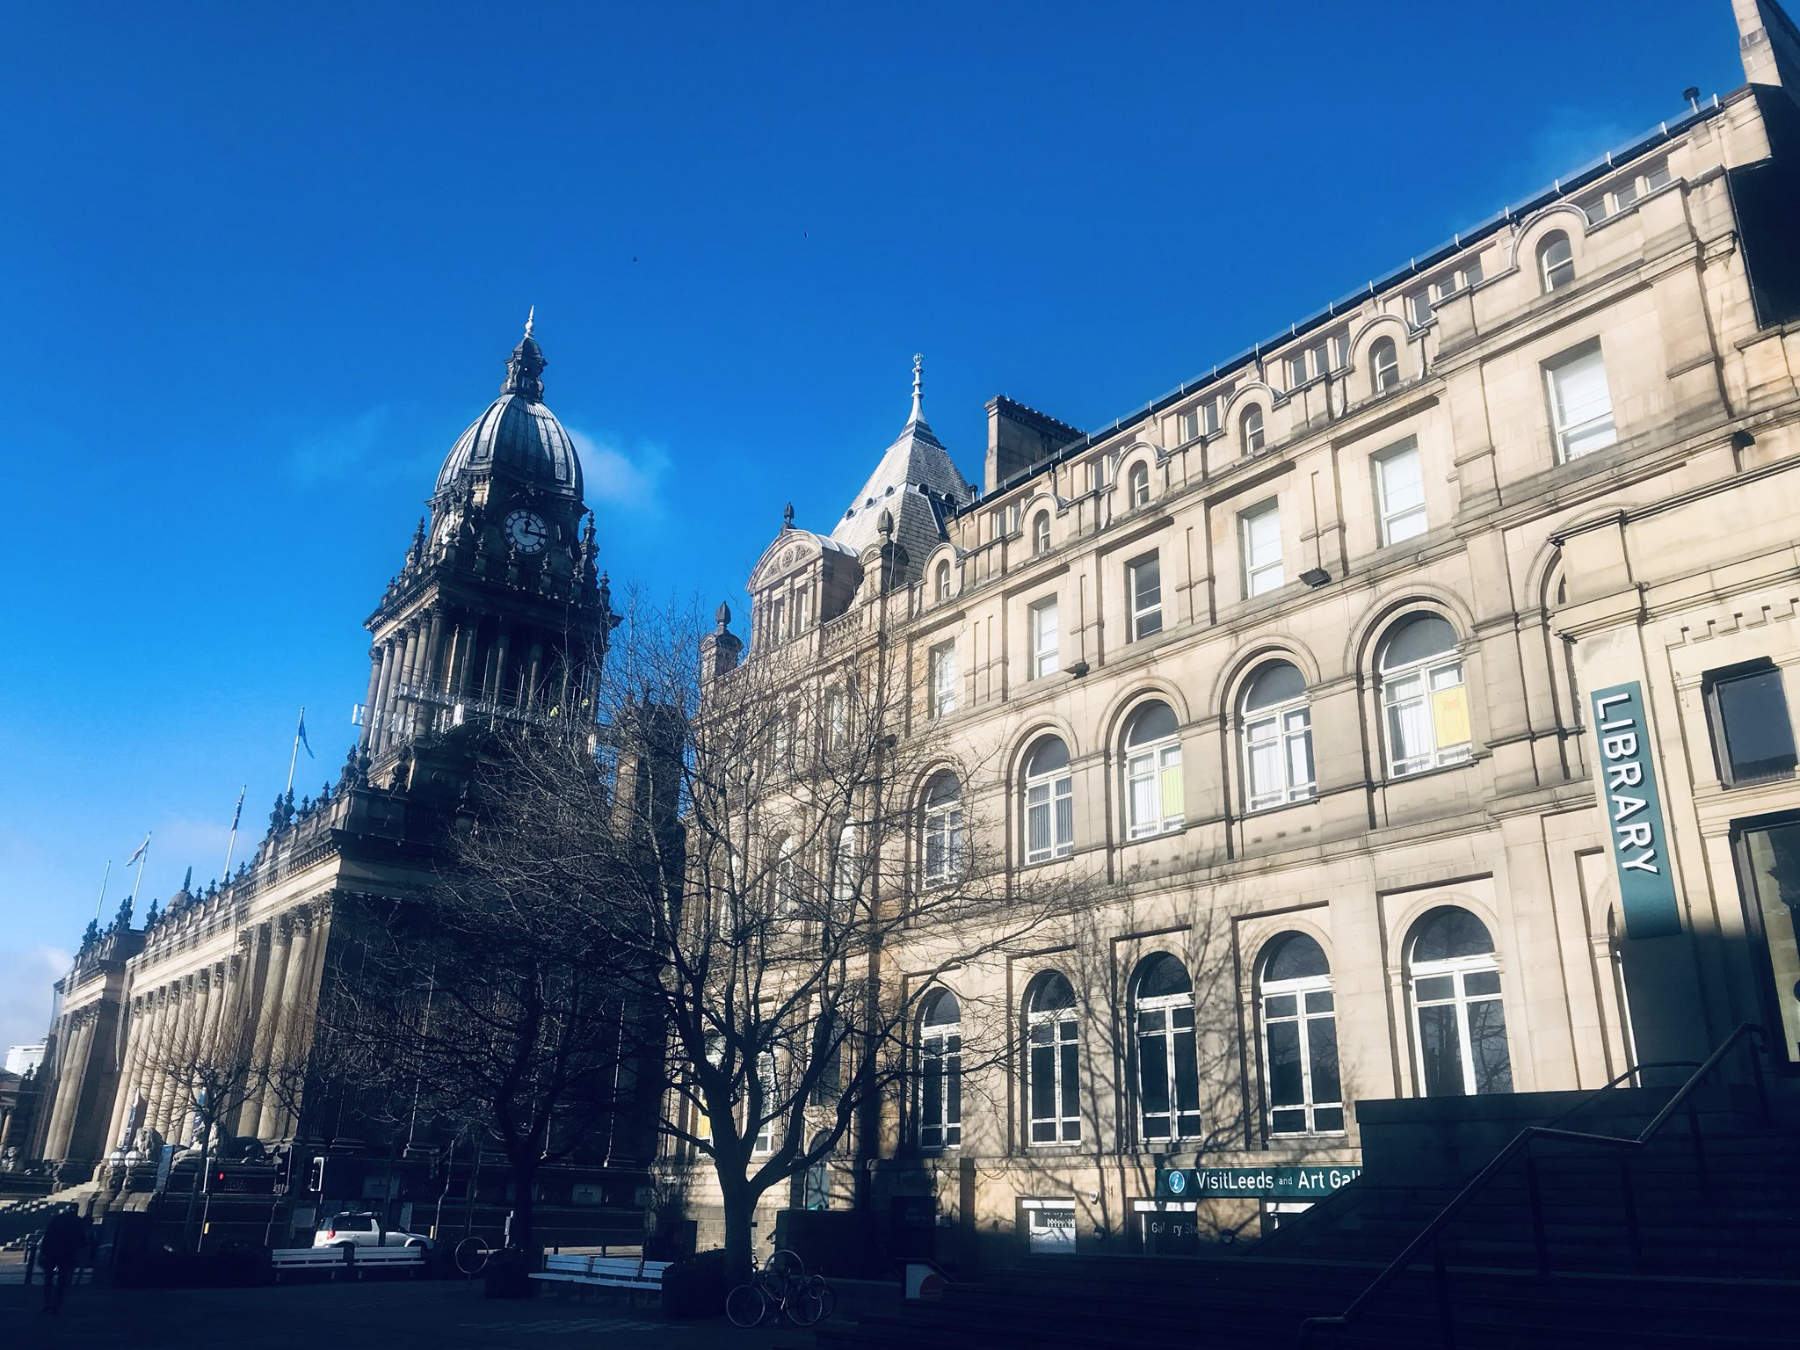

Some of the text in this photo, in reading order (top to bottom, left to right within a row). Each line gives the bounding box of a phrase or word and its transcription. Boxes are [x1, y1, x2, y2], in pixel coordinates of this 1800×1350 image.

[1597, 692, 1659, 873] LIBRARY
[1196, 1170, 1275, 1189] VisitLeeds
[1278, 1176, 1293, 1185] and
[1298, 1170, 1325, 1189] Art
